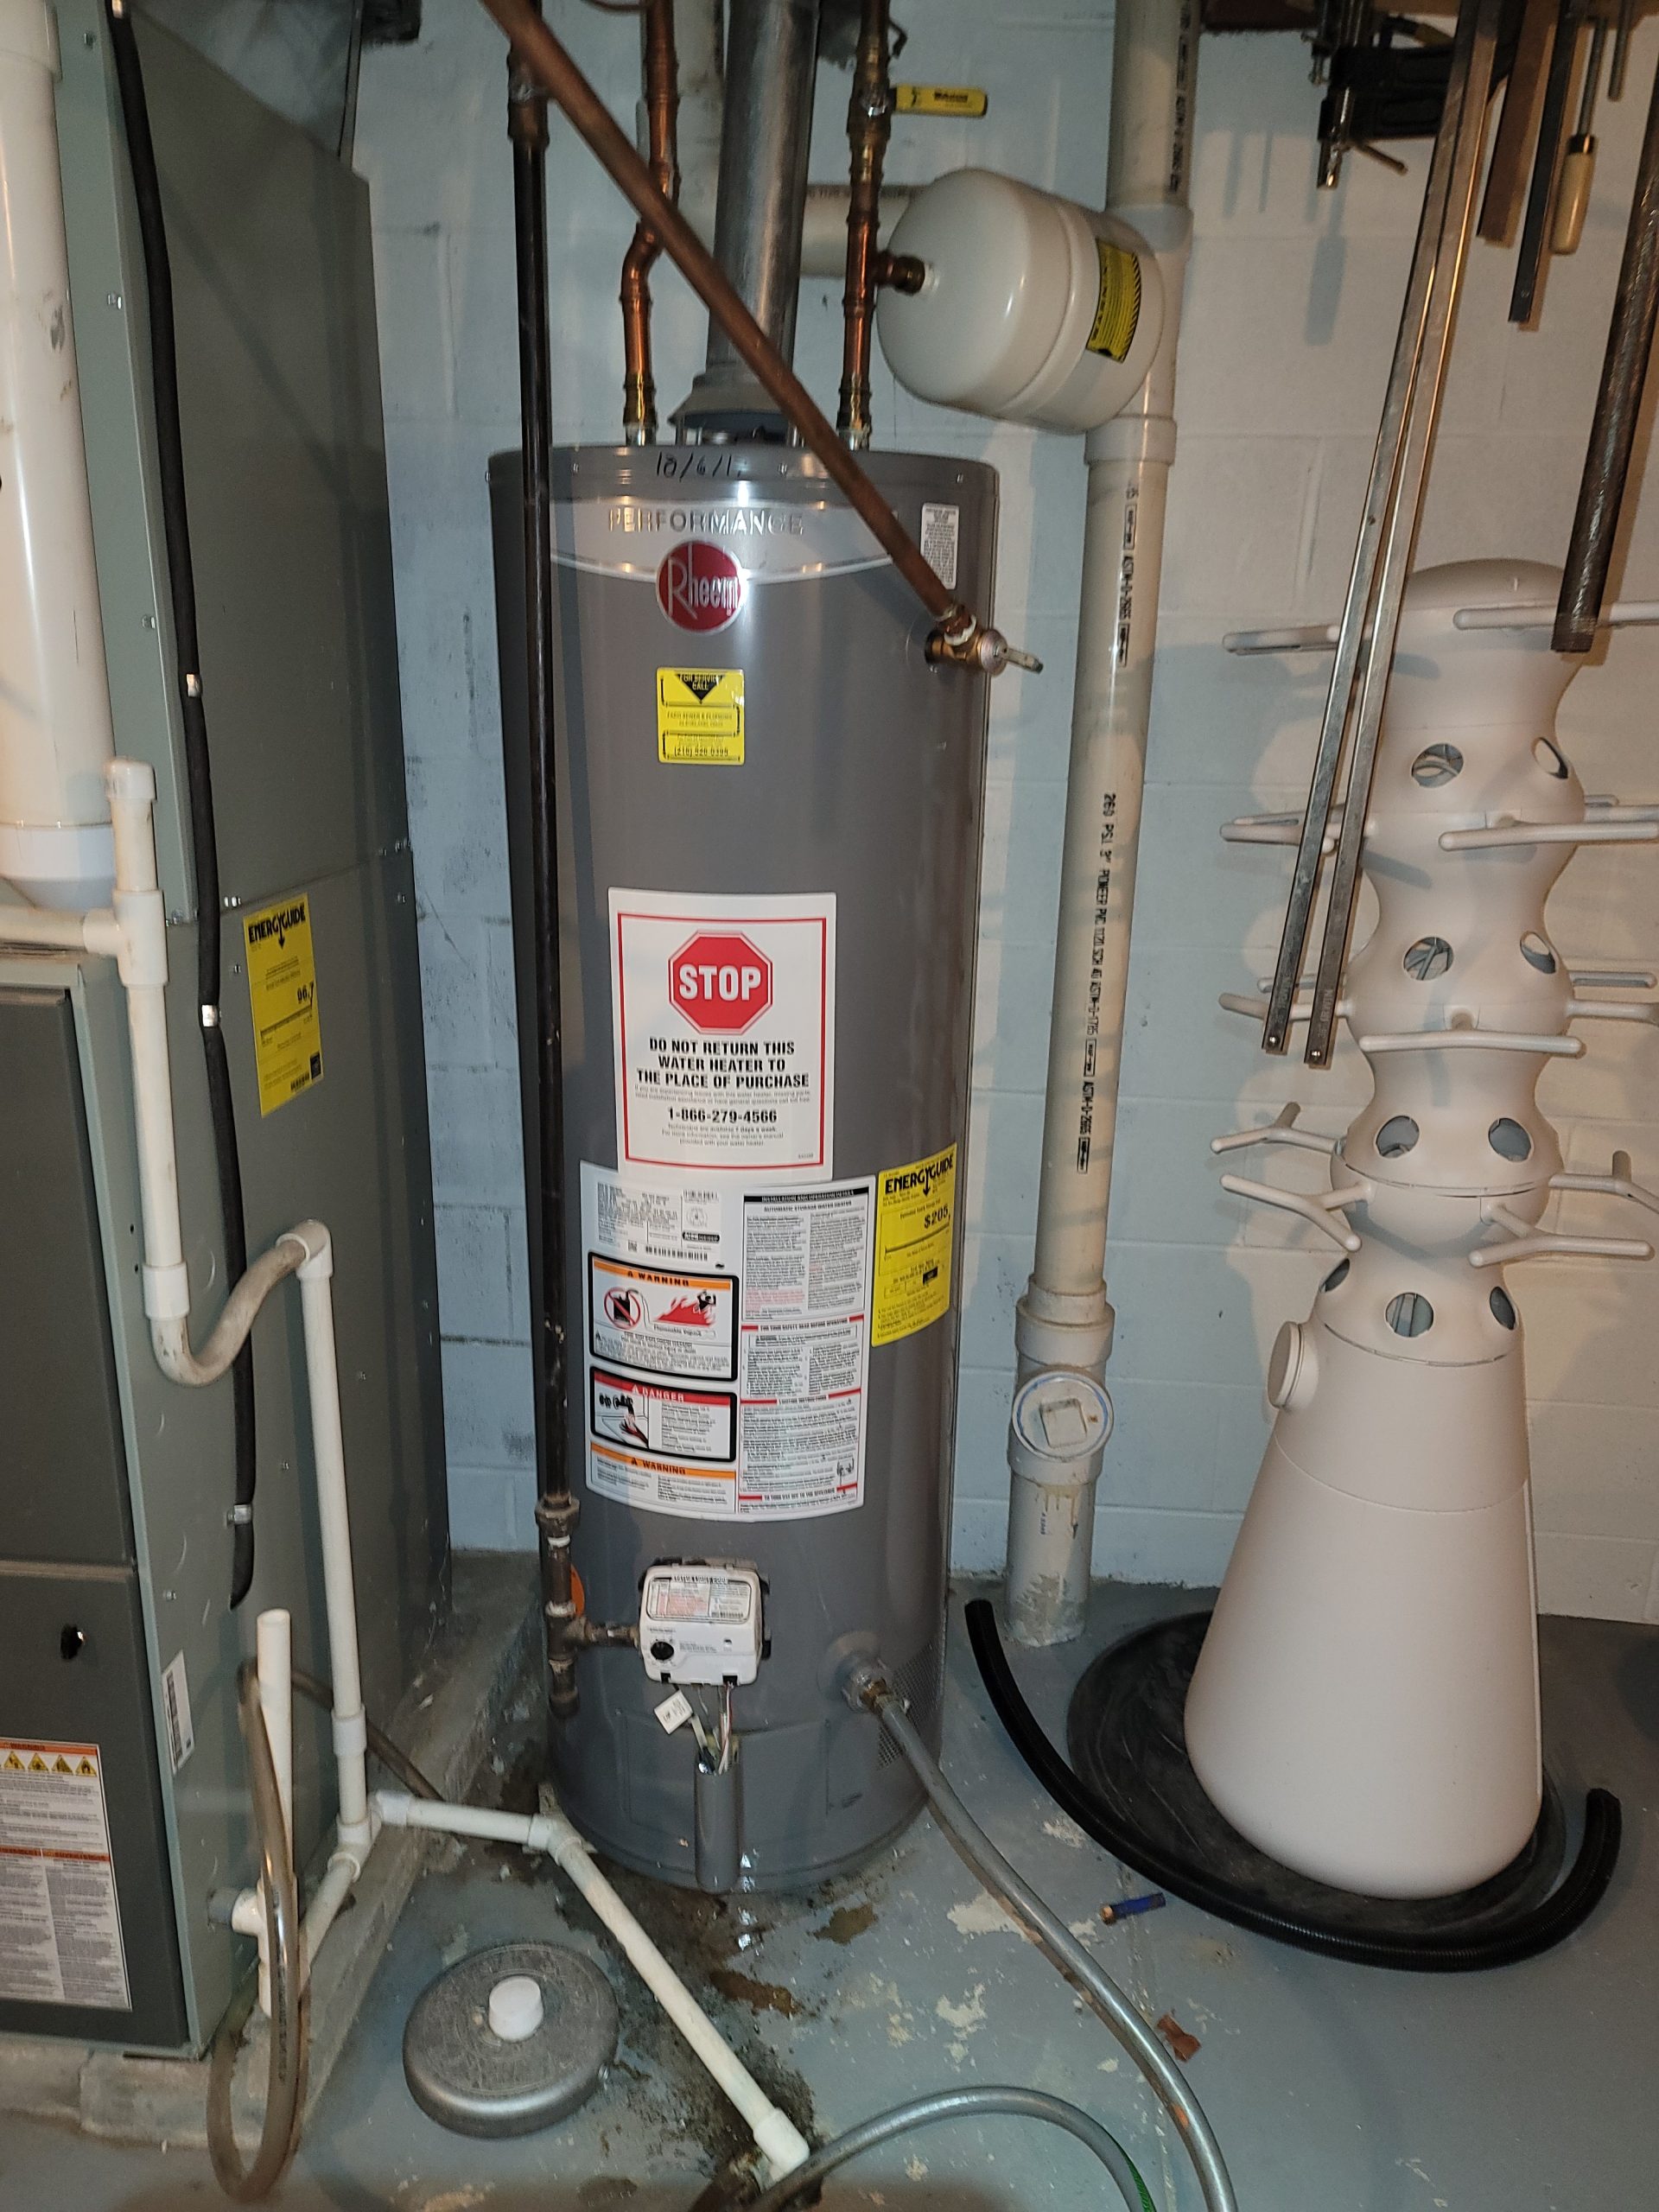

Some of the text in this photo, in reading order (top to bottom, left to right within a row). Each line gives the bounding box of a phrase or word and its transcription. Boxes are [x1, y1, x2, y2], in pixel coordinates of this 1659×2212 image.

[608, 506, 804, 536] PERFORMANCE
[667, 541, 739, 620] Rheem
[692, 682, 709, 690] CALL
[1103, 792, 1116, 817] 260
[1101, 823, 1114, 844] PSI
[1096, 869, 1110, 906] PIONEER
[1095, 908, 1108, 925] PVC
[1091, 948, 1103, 965] SCH
[679, 964, 761, 1001] STOP
[1087, 981, 1102, 1036] ASTM-D-1785
[649, 1036, 795, 1056] DO NOT RETURN THIS
[658, 1054, 785, 1072] WATER HEATER TO
[637, 1068, 810, 1089] THE PLACE OF PURCHASE
[667, 1105, 778, 1124] 1-866-279-4566
[885, 1154, 953, 1195] ENERGYGUIDE
[924, 1204, 949, 1229] $205
[638, 1272, 690, 1287] WARNING
[642, 1386, 684, 1402] DANGER
[642, 1459, 686, 1475] WARNING
